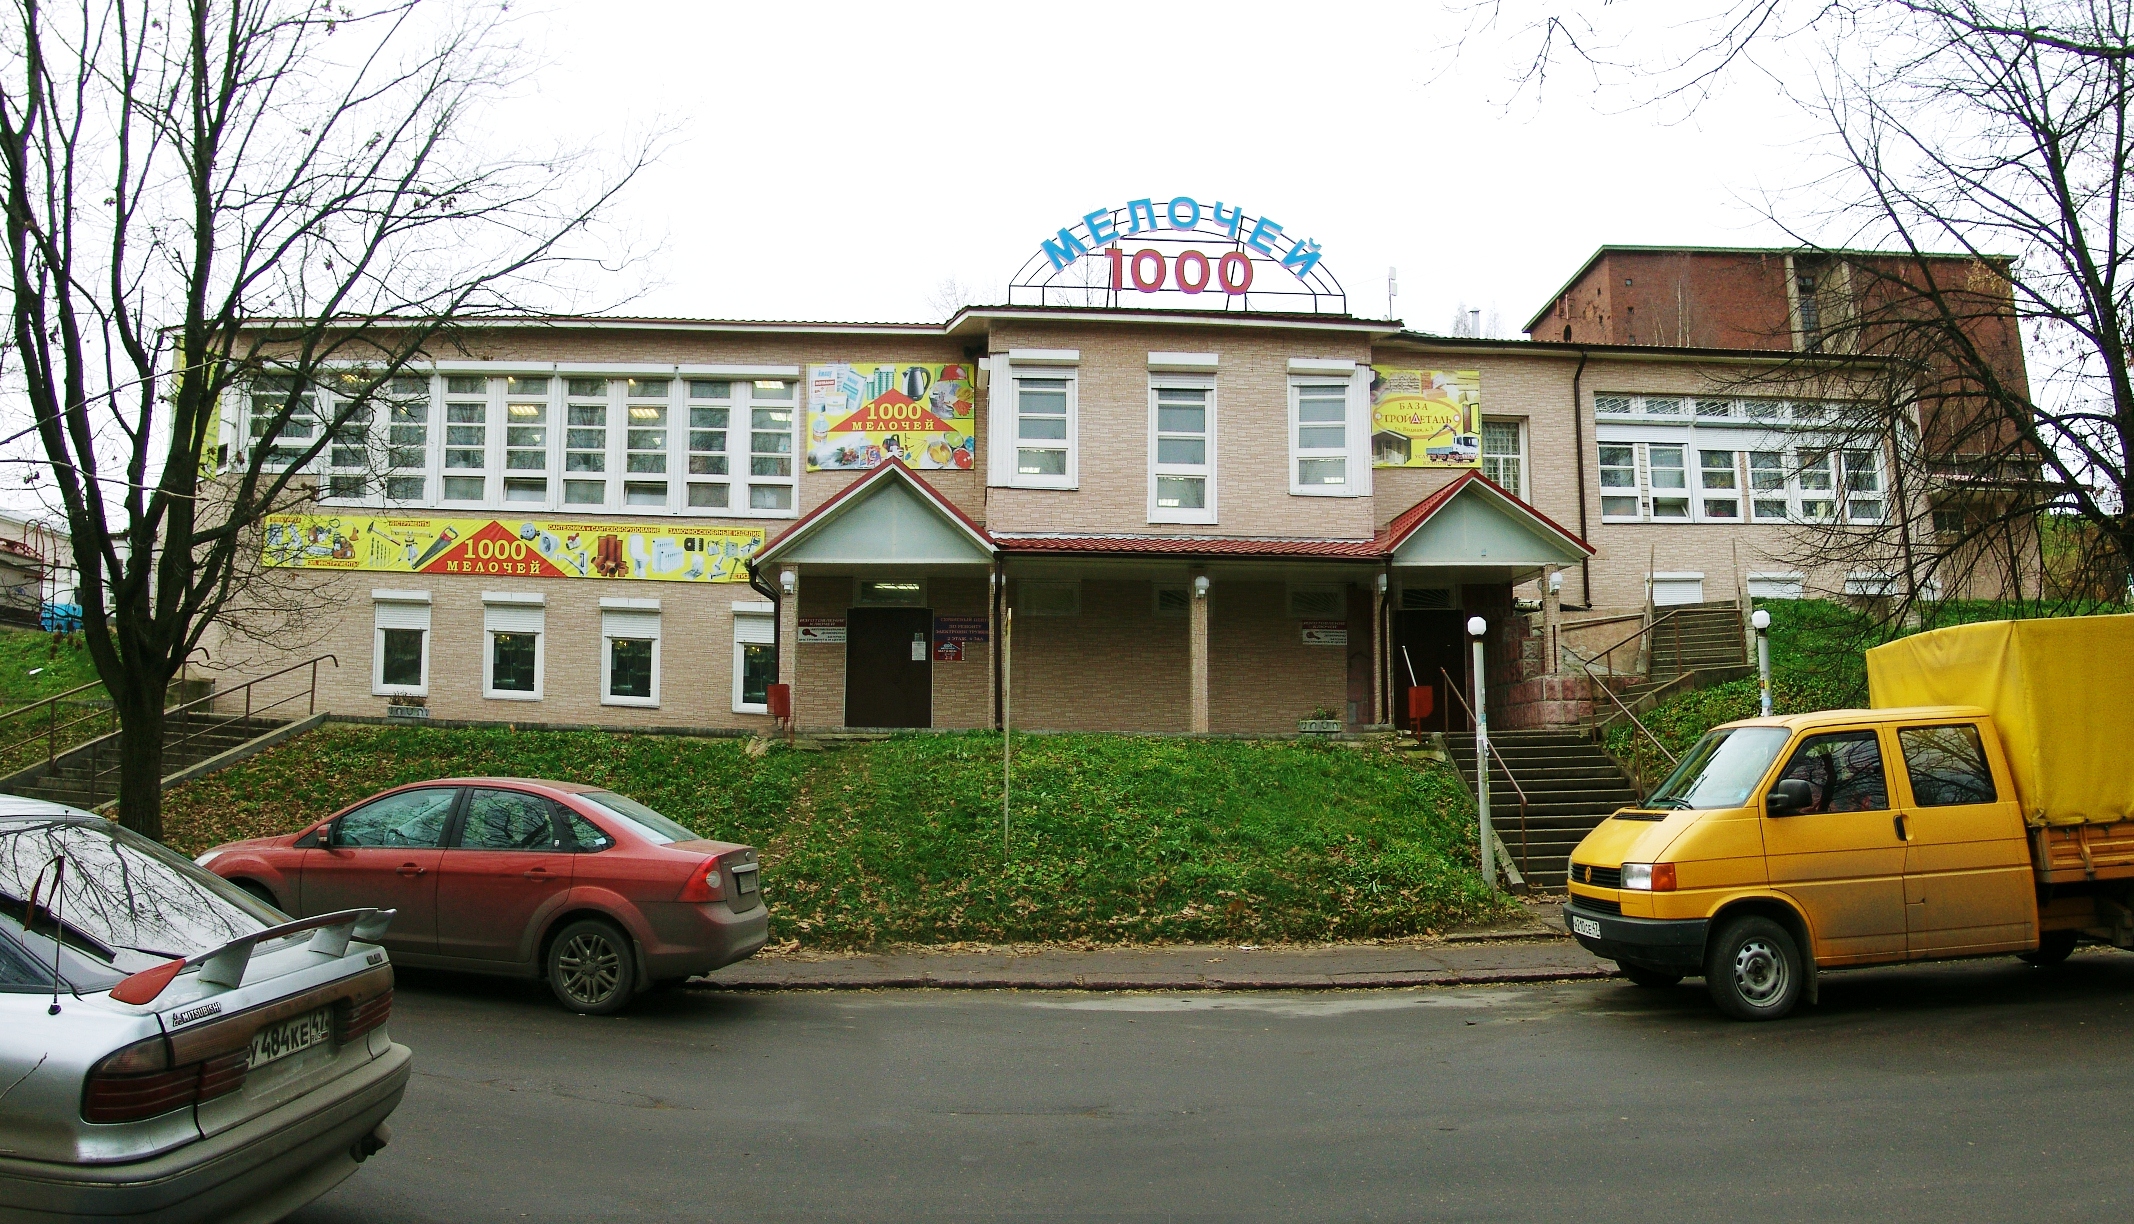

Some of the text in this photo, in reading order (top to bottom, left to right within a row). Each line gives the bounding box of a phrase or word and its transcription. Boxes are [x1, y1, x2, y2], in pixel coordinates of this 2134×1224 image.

[1040, 196, 1322, 280] МЕЛОЧЕЙ
[1104, 248, 1254, 296] 1000
[868, 403, 921, 420] 1000
[1399, 402, 1428, 410] БАЗА
[852, 419, 934, 431] МЕЛОЧЕЙ
[1380, 412, 1452, 424] ТРОЙДЕТАЛЬ
[464, 539, 527, 560] 1000
[446, 560, 541, 574] МЕЛОЧЕЙ
[182, 1002, 222, 1023] MITSUBISHI
